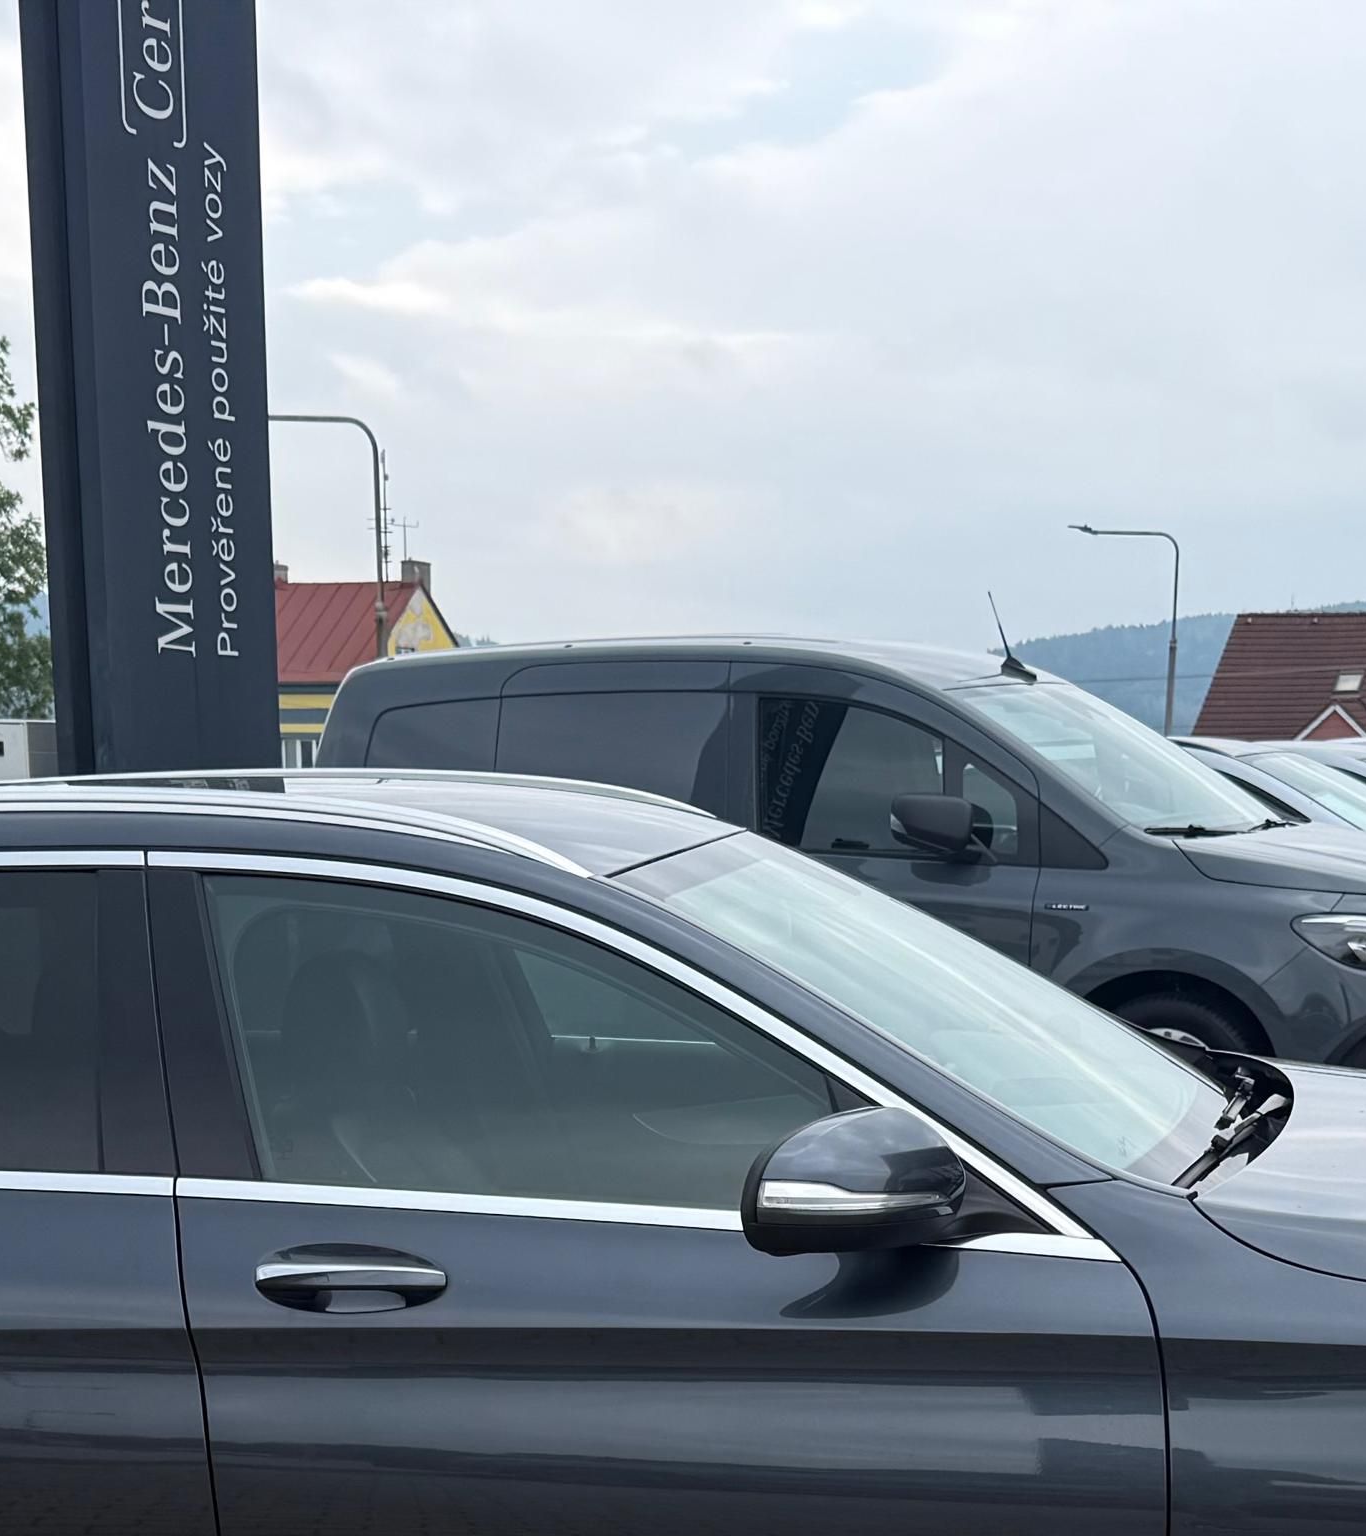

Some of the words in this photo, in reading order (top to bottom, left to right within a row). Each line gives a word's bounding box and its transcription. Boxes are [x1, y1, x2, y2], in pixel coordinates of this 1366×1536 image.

[203, 141, 227, 243] vozy
[141, 158, 196, 657] Mercedes-Benz
[200, 259, 236, 422] použité
[207, 437, 240, 657] Prověřené
